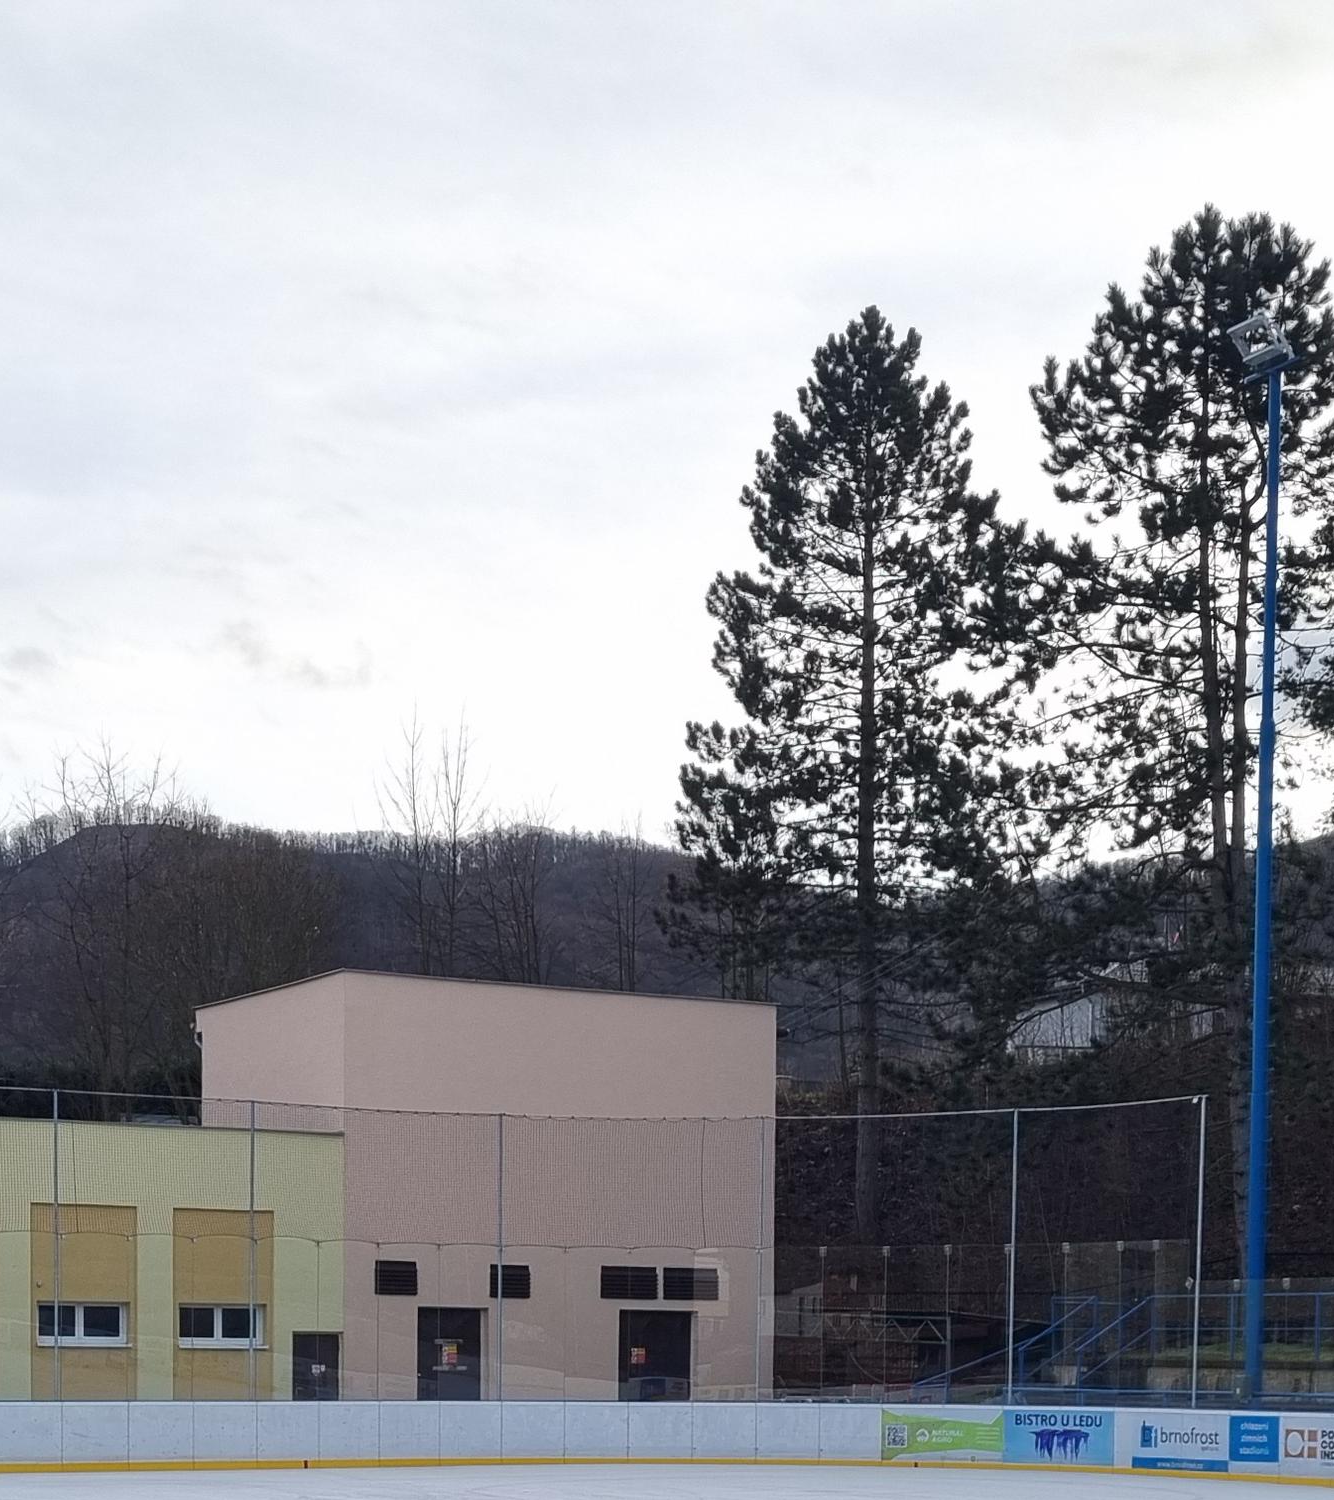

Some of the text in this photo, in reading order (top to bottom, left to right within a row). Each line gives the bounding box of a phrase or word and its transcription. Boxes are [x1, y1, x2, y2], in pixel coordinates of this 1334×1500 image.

[1015, 1413, 1103, 1427] BISTRO U LEDU
[1160, 1427, 1219, 1446] brnofrost
